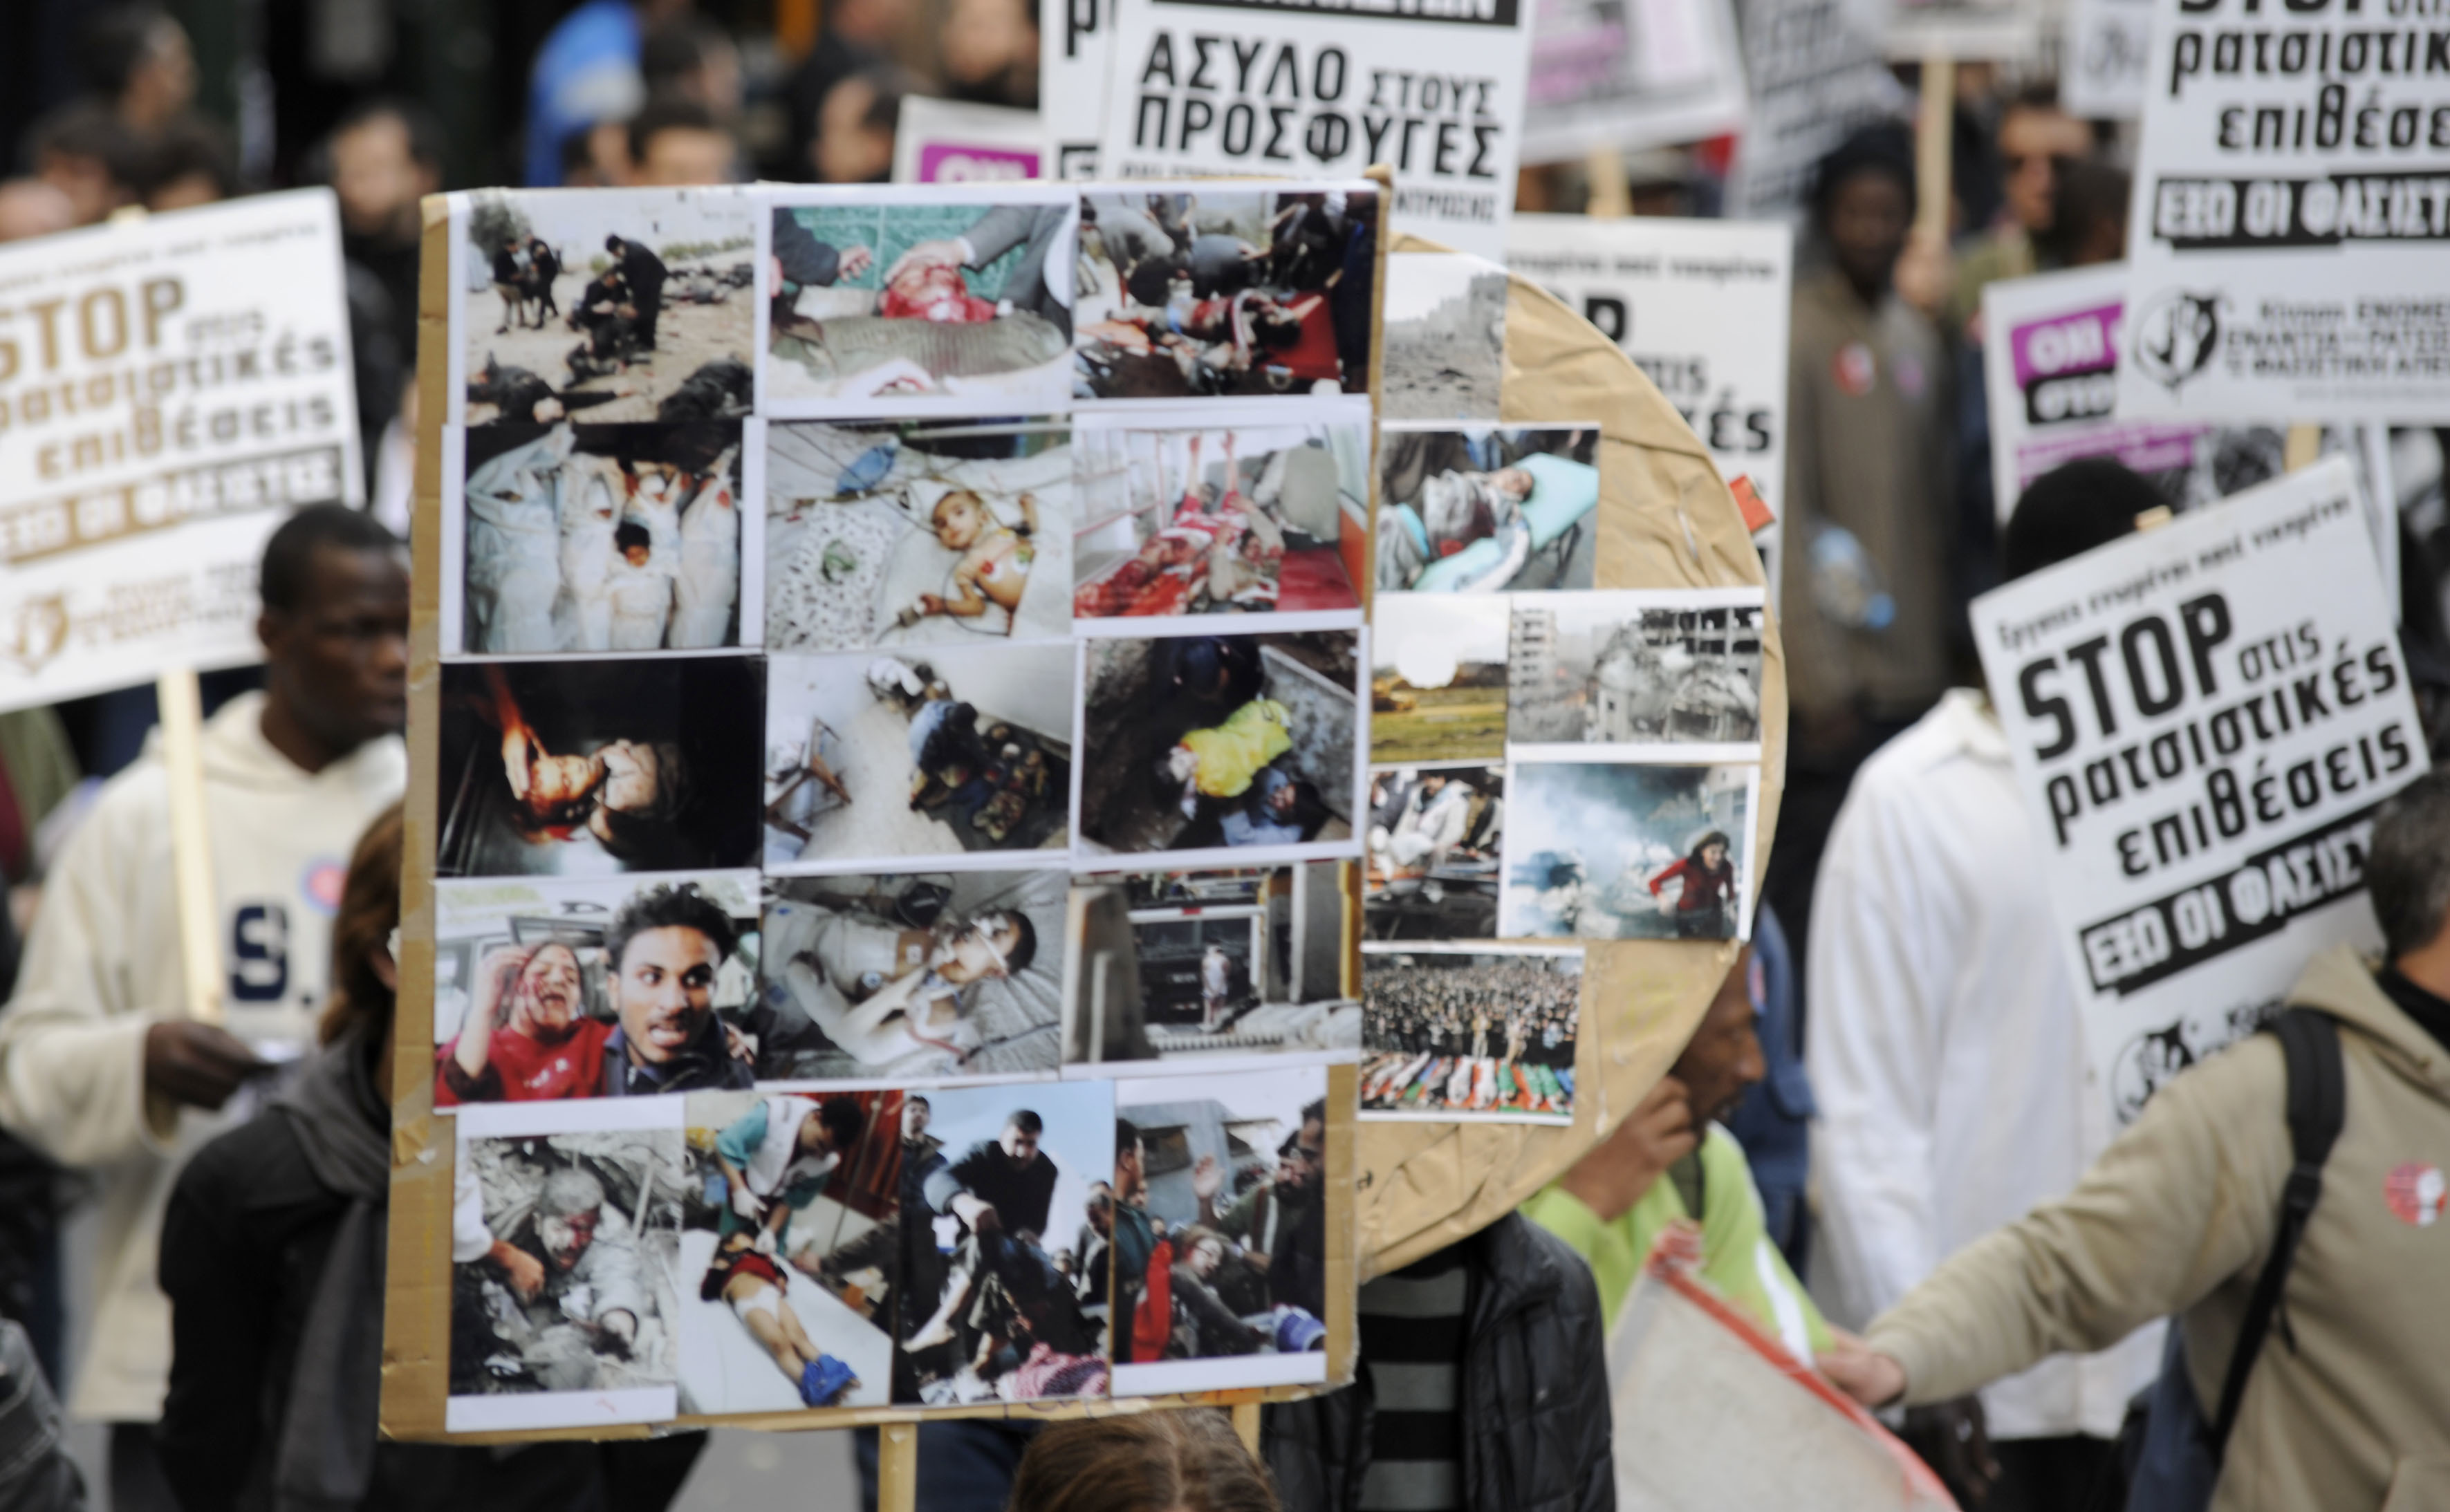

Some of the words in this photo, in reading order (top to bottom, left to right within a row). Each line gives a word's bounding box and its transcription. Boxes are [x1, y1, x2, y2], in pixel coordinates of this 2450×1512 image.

[1140, 31, 1346, 102] ΑΣΥΛΟ
[1368, 69, 1496, 115] ΣΤΟΥΣ
[1134, 95, 1503, 178] ΠΡΟΣΦΥΓΕΣ
[0, 330, 335, 430] ατσιστικές
[2019, 592, 2234, 761] STOP
[2238, 622, 2321, 686] στις
[2045, 639, 2398, 850] ρατσιστικές
[2116, 723, 2412, 877] επιθέσεις
[2173, 885, 2227, 950] ΟΙ
